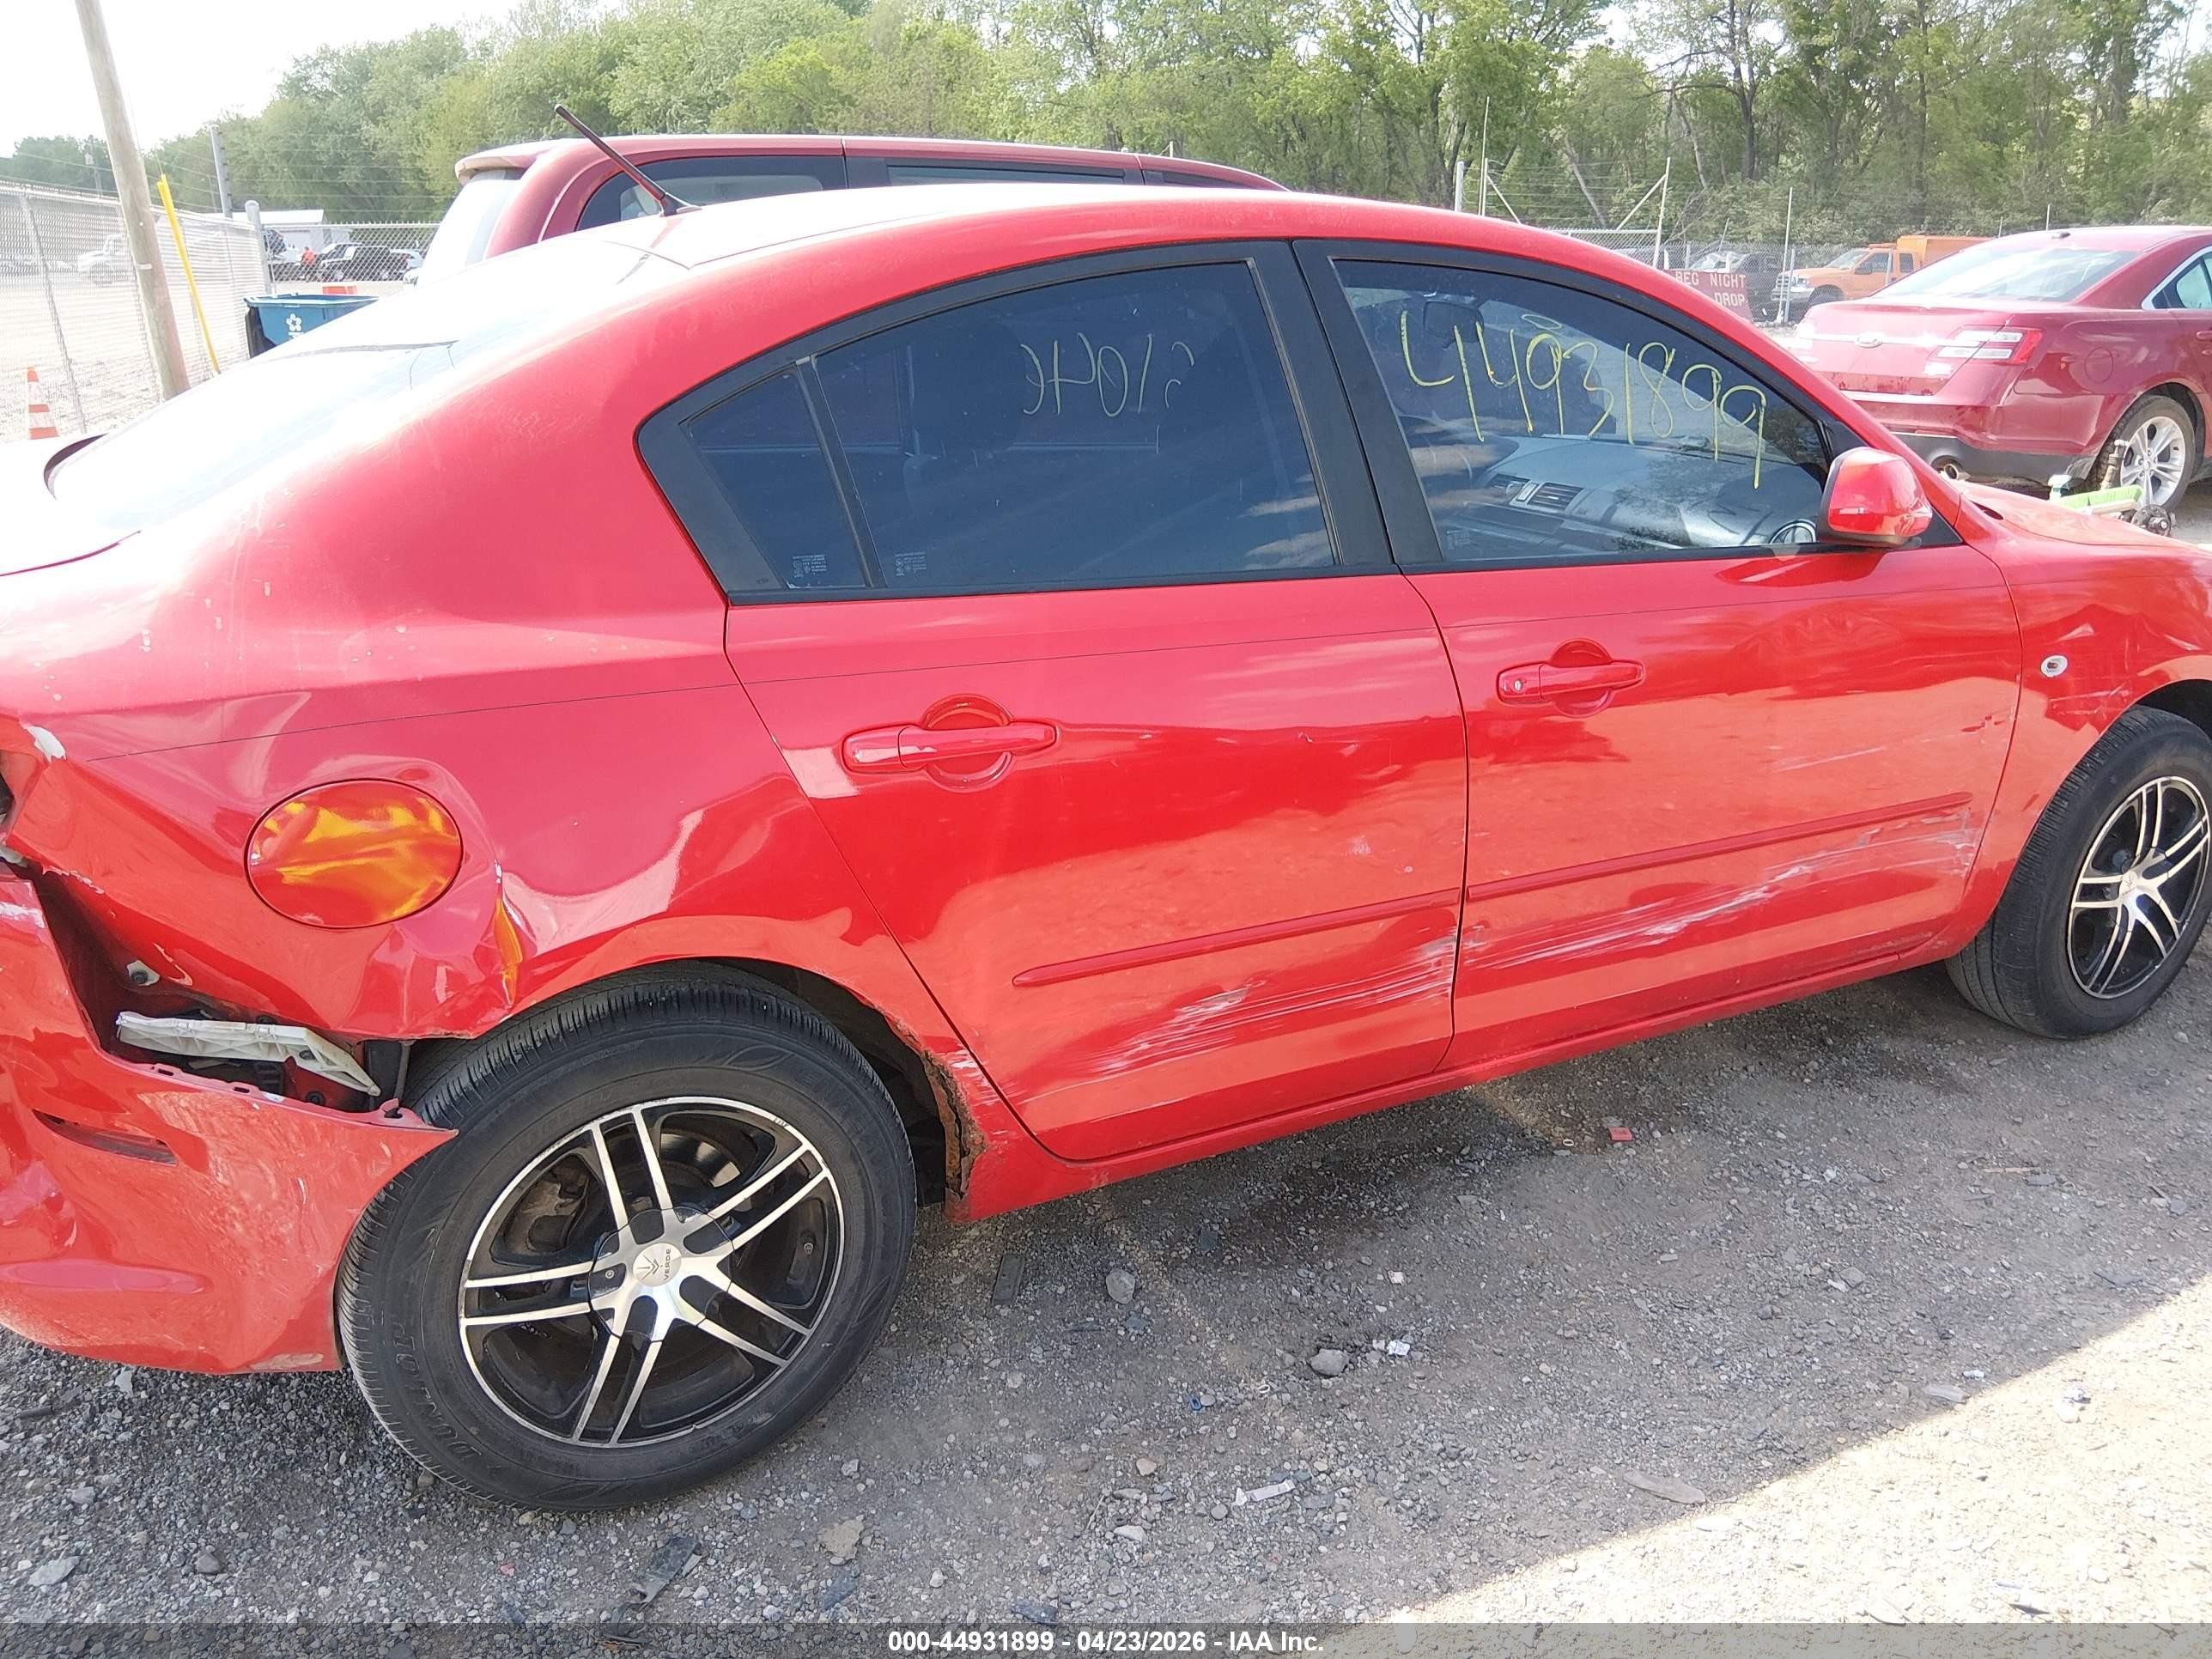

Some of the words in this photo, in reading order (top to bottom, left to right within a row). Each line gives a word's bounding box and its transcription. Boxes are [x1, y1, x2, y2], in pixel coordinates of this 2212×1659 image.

[1710, 273, 1747, 289] NIGHT
[1714, 292, 1746, 307] DROP
[1401, 310, 1769, 490] 44931899
